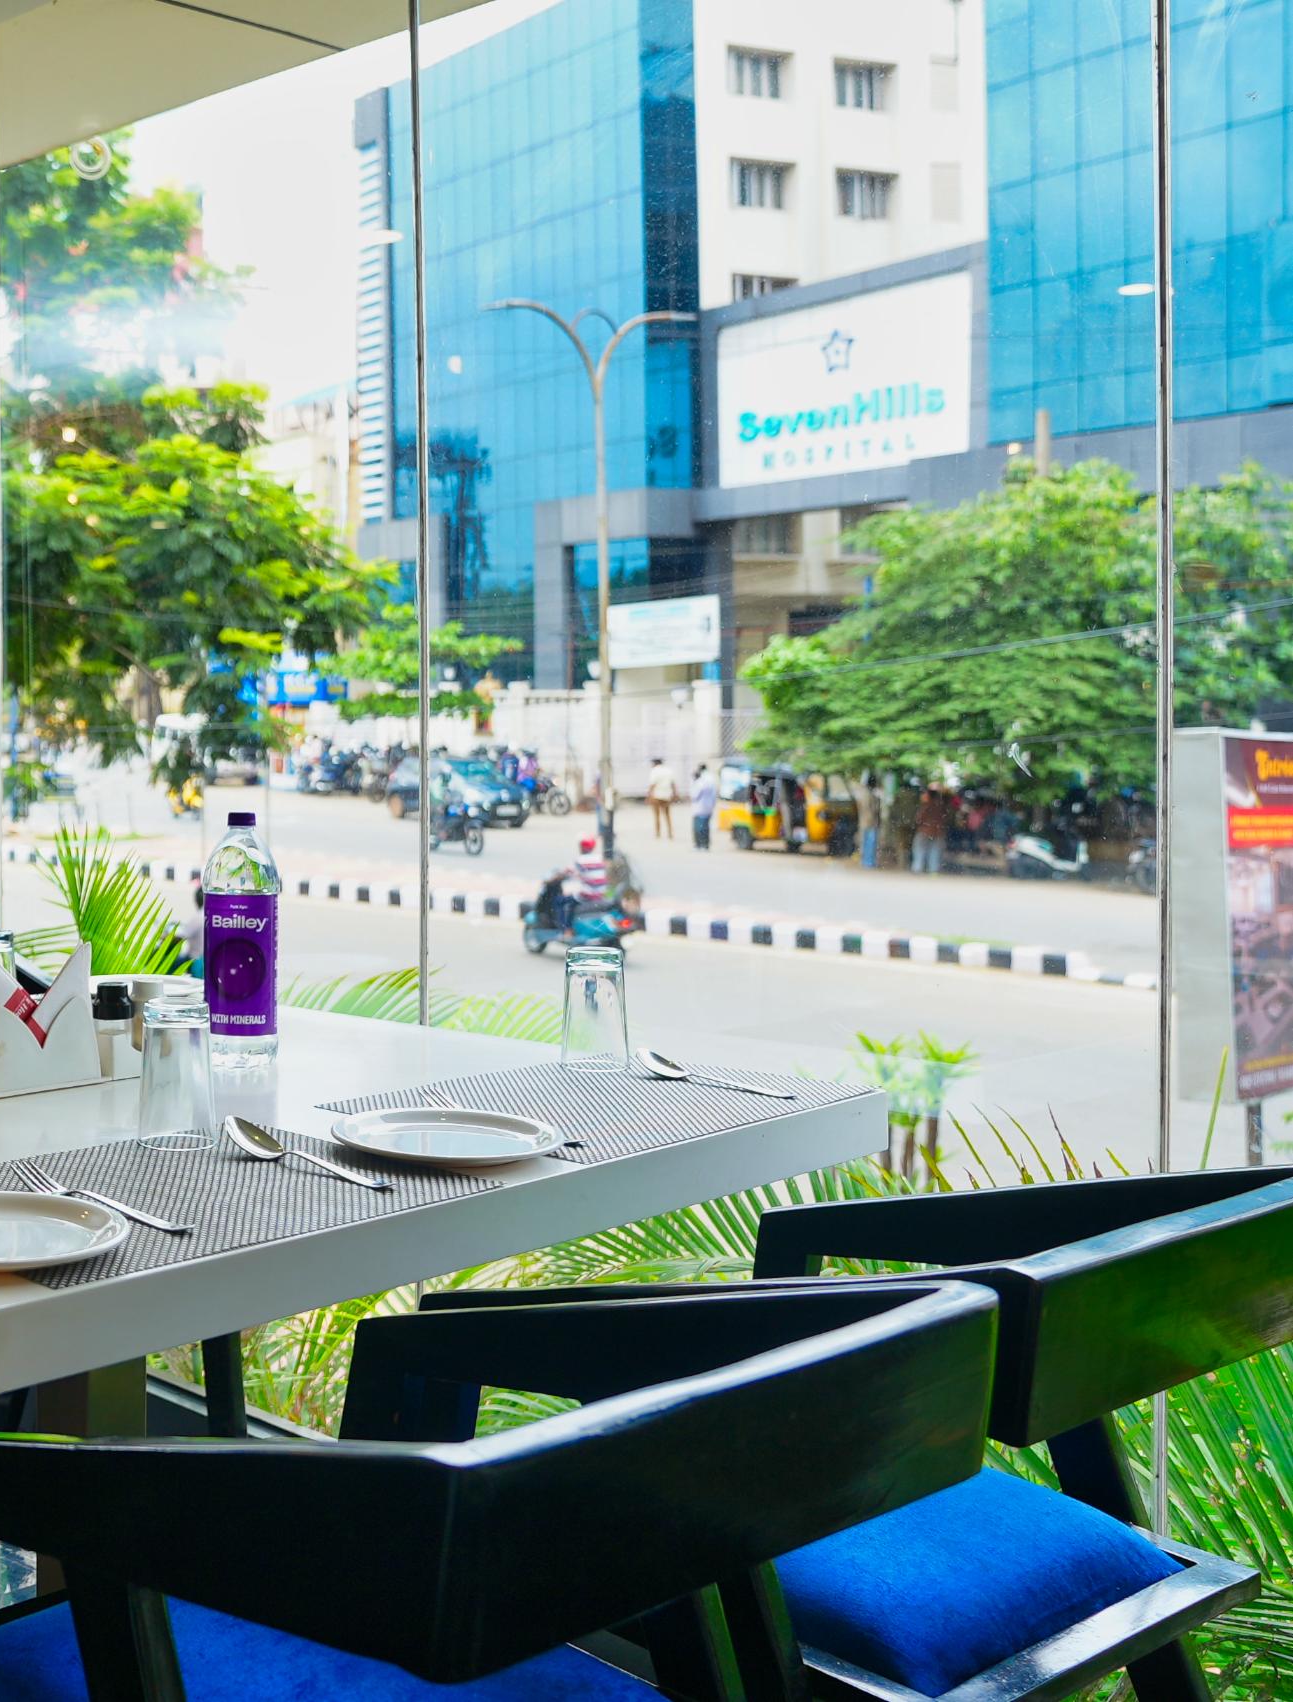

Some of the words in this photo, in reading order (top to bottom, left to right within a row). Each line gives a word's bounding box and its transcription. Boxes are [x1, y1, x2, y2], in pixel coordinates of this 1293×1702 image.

[738, 382, 946, 443] SevenHills
[762, 433, 915, 470] HOSPITAL
[212, 914, 267, 932] Bailley
[212, 1014, 229, 1024] WITH
[230, 1014, 266, 1025] MINERALS
